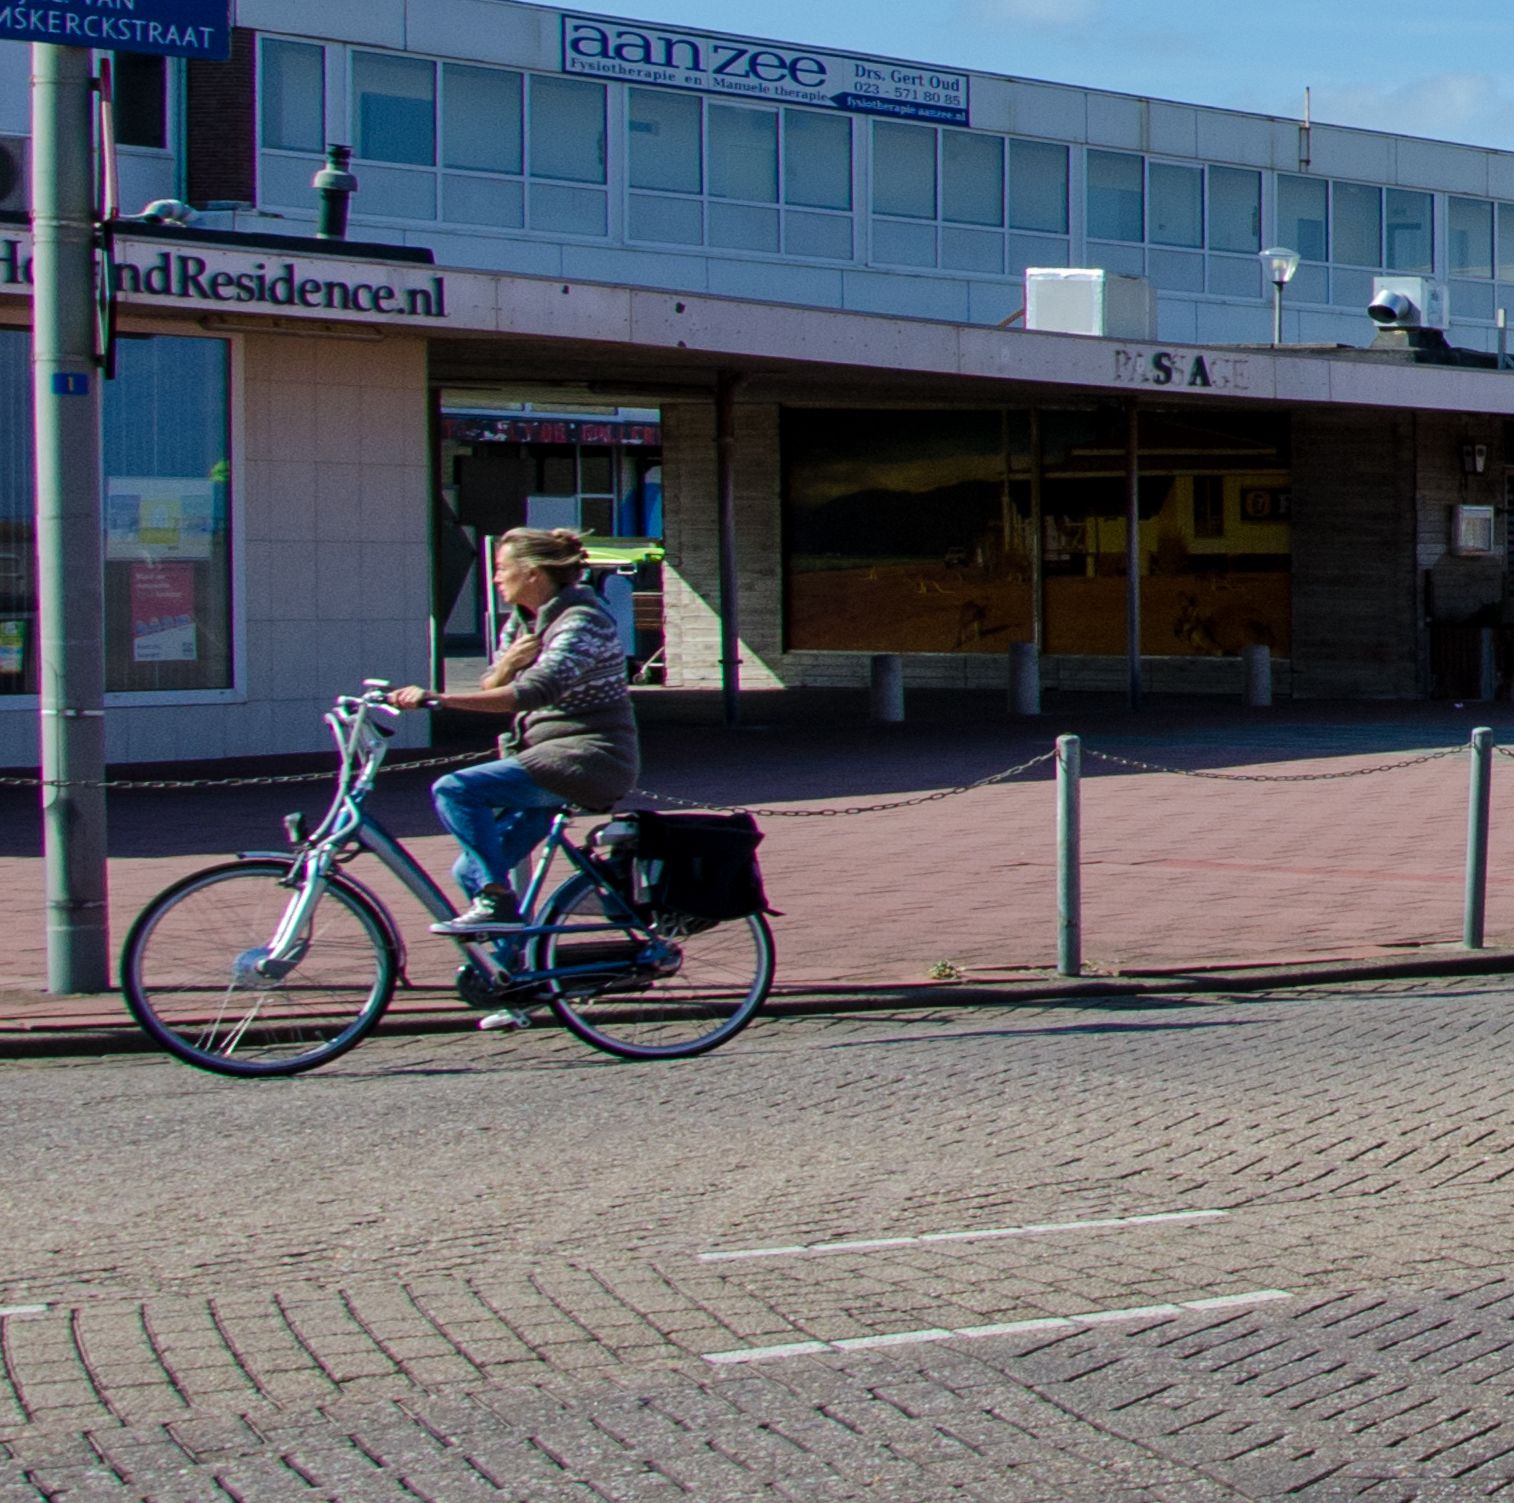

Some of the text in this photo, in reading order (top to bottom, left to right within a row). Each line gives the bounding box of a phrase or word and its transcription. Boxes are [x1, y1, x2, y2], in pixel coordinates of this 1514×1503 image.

[570, 57, 829, 104] Fysiotherapie en Manuele therapie
[853, 80, 880, 95] 023
[894, 86, 918, 101] 571
[923, 91, 941, 104] 80
[854, 63, 961, 92] Drs. Gert Oud
